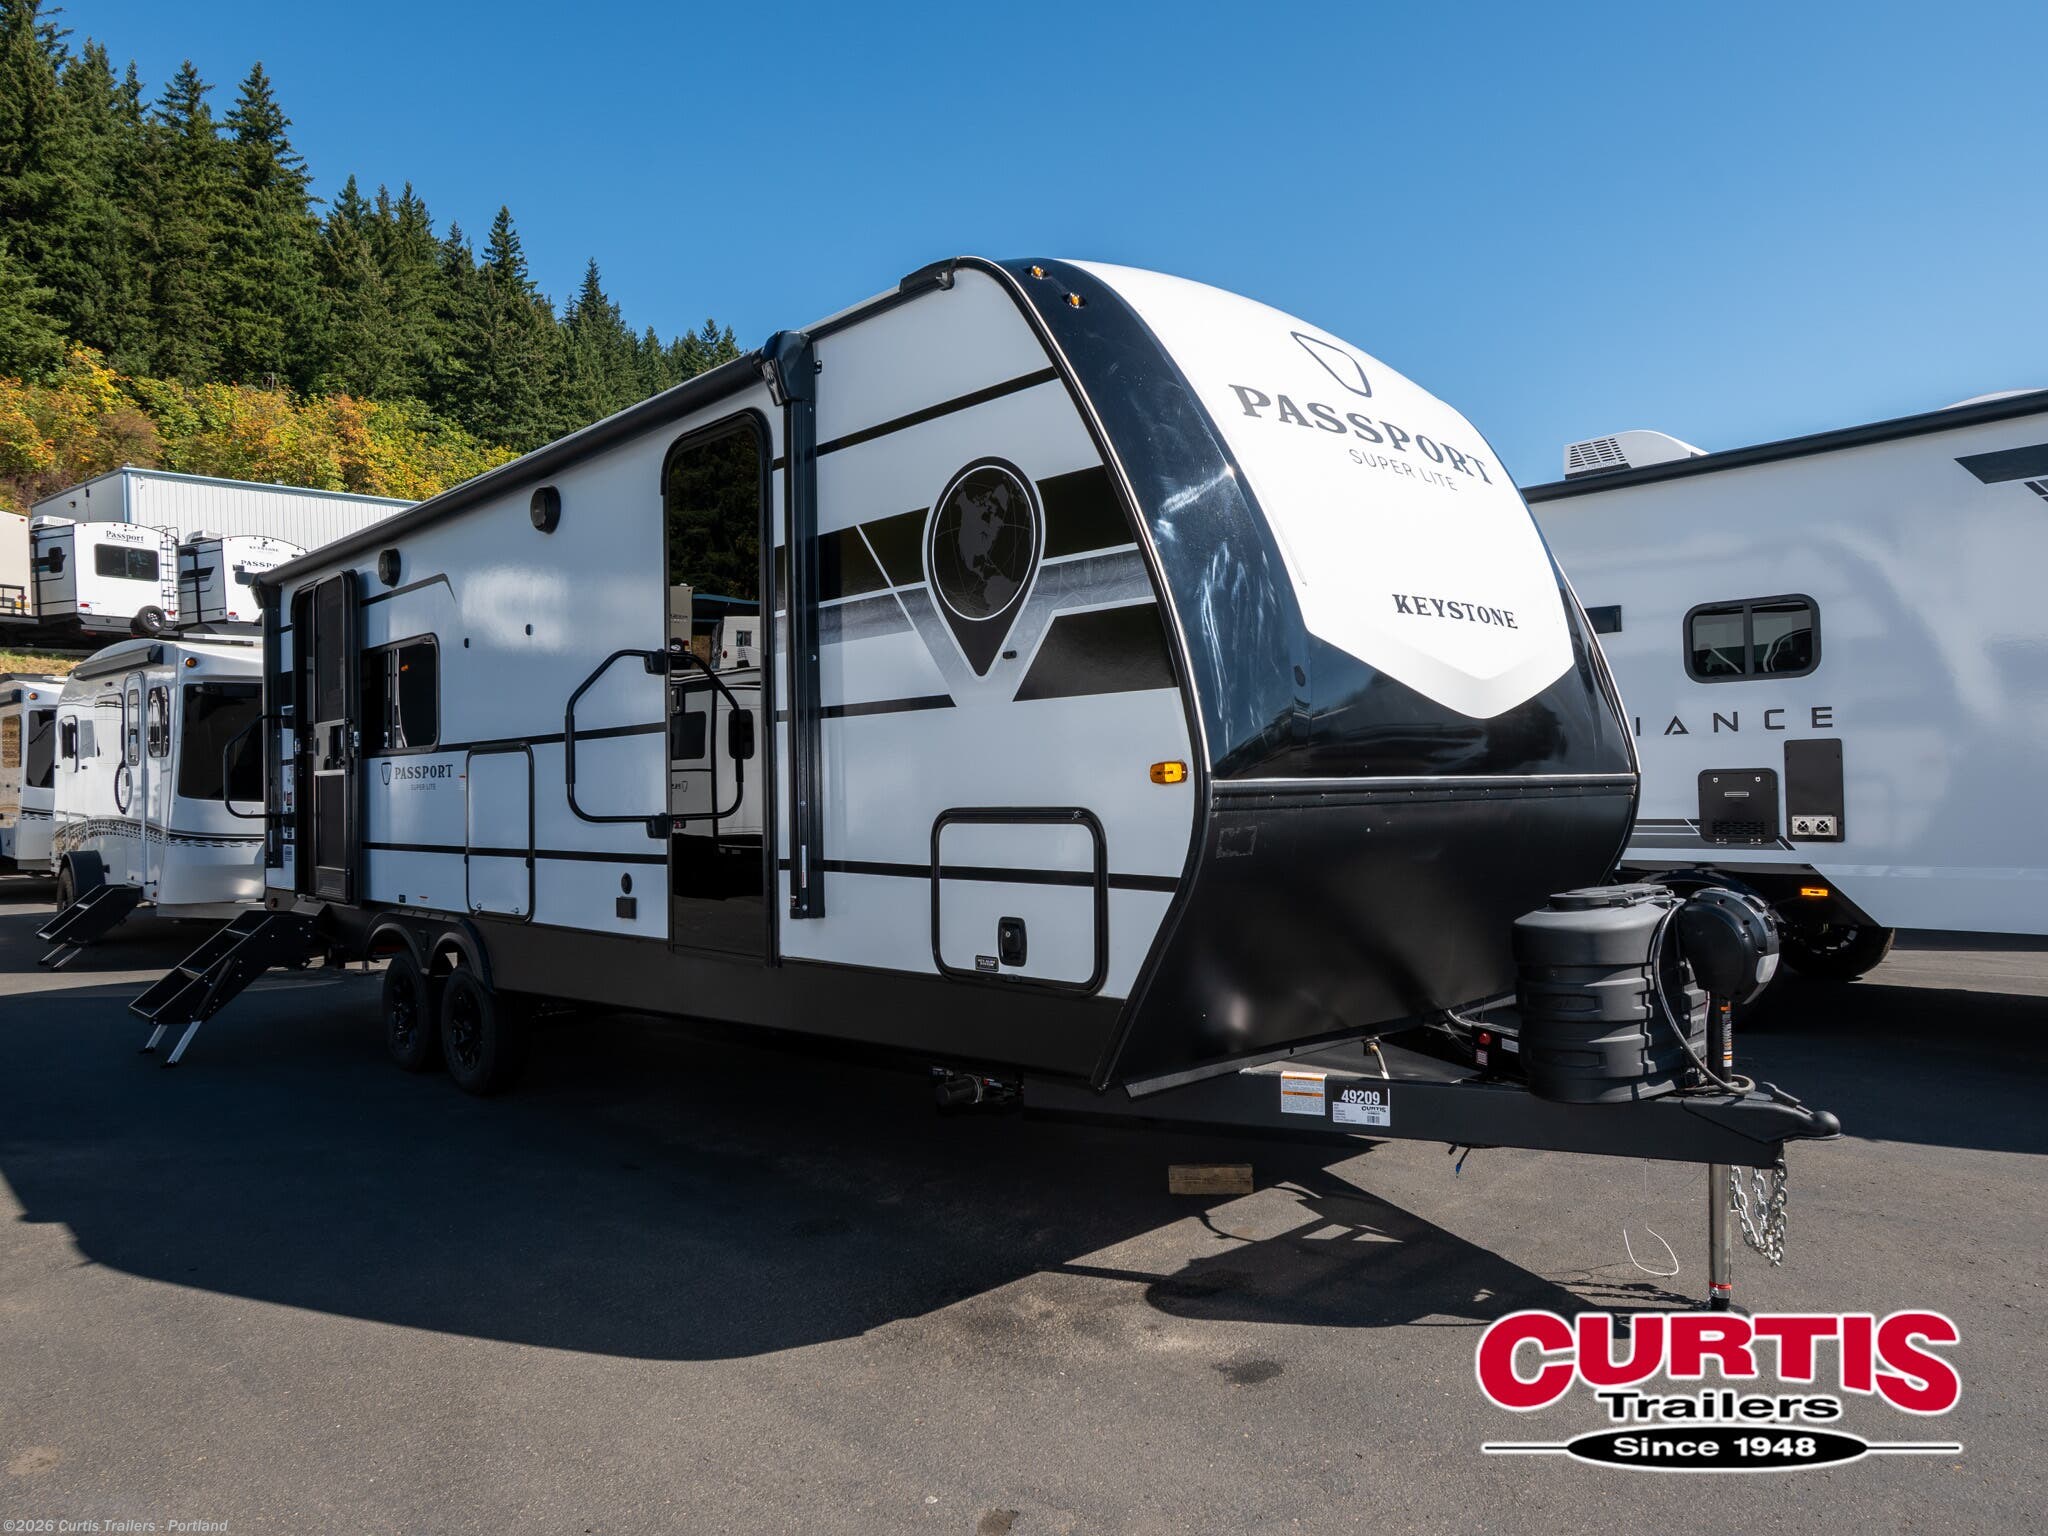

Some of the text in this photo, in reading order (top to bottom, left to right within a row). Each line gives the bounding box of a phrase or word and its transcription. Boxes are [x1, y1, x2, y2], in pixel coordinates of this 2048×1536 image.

[1228, 384, 1493, 485] PASSPORT
[1349, 447, 1459, 492] SUPER LITE
[106, 530, 144, 543] Passport
[240, 559, 279, 568] PASSPO
[1391, 593, 1519, 630] KEYSTONE
[1636, 706, 1833, 736] IANCE
[394, 764, 453, 779] PASSPORT
[1341, 1089, 1380, 1105] 49209
[1361, 1105, 1387, 1113] CURTIS
